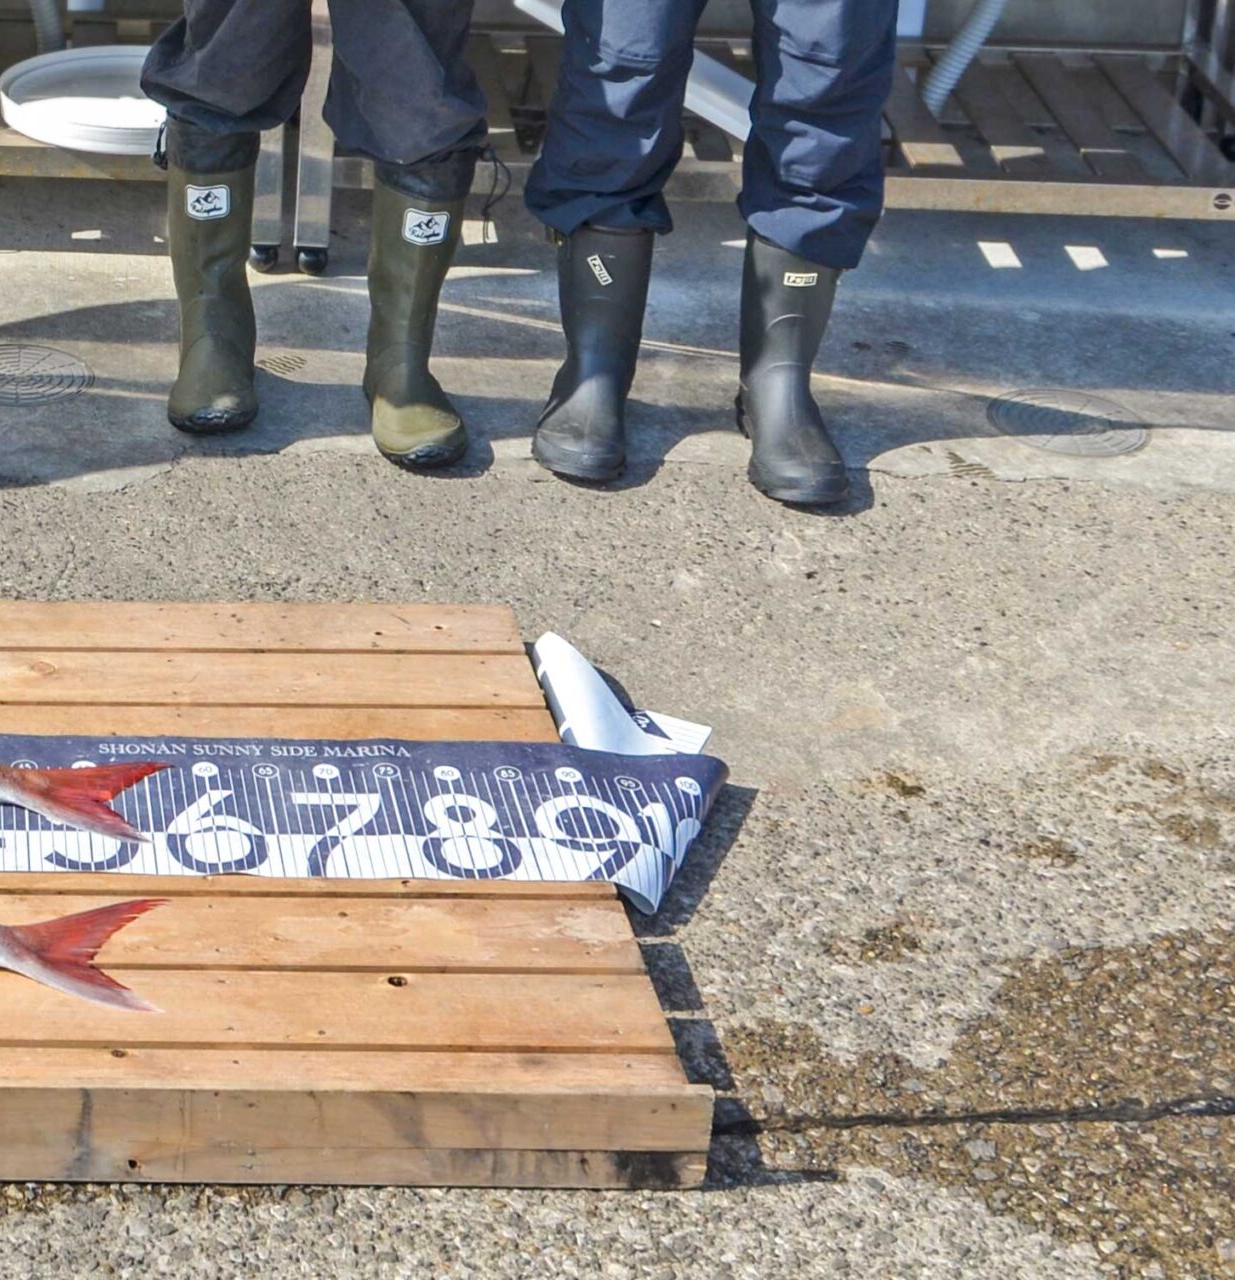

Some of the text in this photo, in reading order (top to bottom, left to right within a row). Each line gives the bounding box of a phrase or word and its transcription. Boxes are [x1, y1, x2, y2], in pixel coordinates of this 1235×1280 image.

[99, 743, 411, 757] SHONAN SUNNY SIDE MARINA
[167, 790, 269, 873] 6
[291, 793, 380, 876] 7
[422, 793, 522, 878] 8
[535, 795, 641, 880] 9
